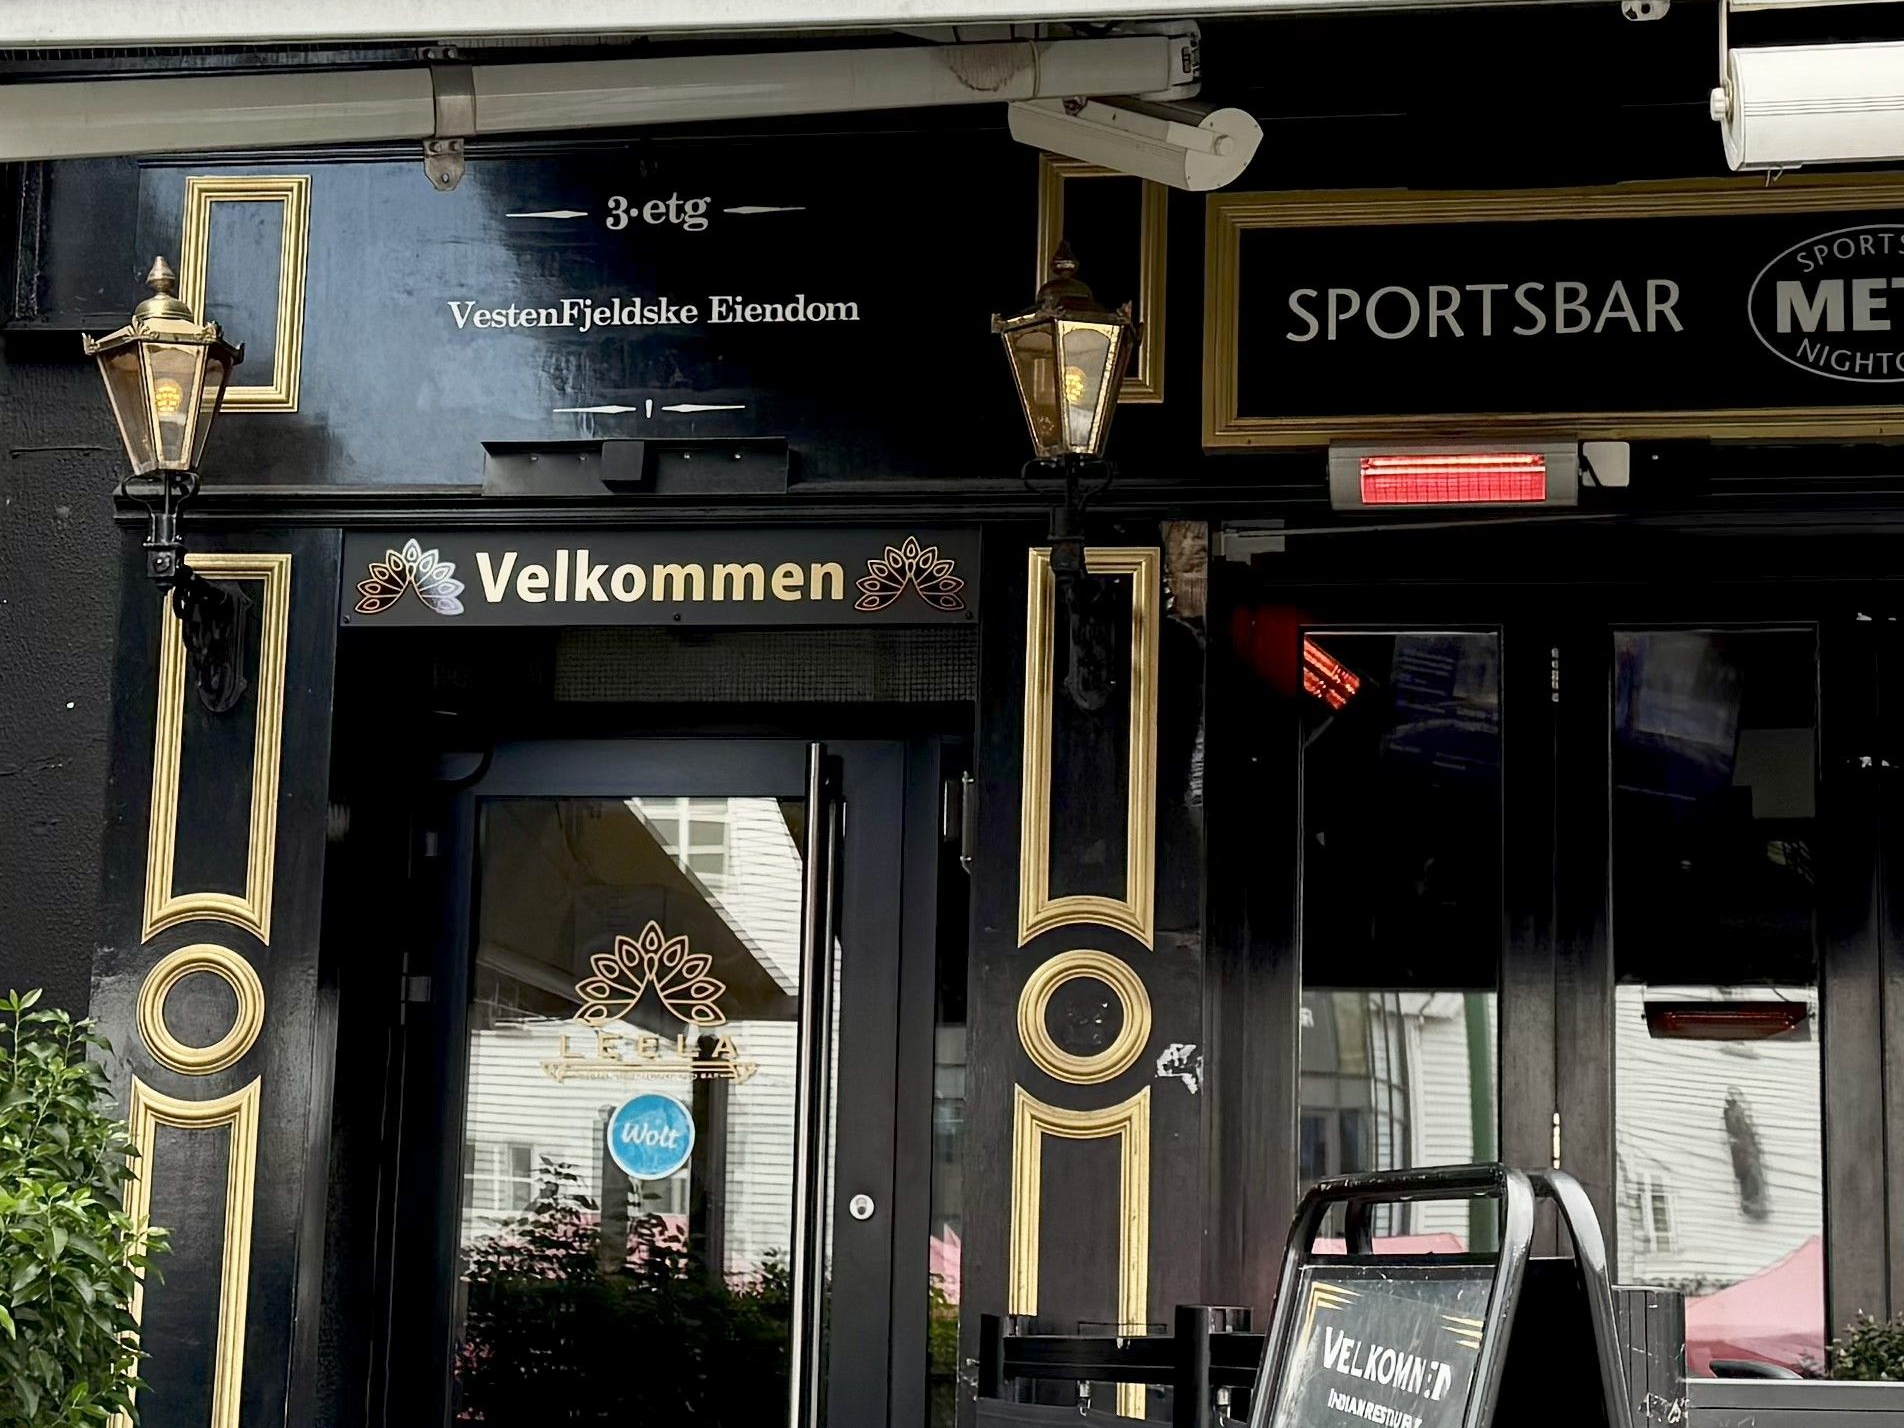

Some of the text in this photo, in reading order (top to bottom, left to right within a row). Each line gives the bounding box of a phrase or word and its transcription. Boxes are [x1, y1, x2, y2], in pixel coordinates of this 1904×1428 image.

[447, 294, 860, 334] VestenFjeldske Eiendom
[1285, 278, 1684, 342] SPORTSBAR
[475, 549, 845, 604] Velkommen
[559, 1034, 740, 1060] LEELA
[621, 1122, 680, 1150] Wolt
